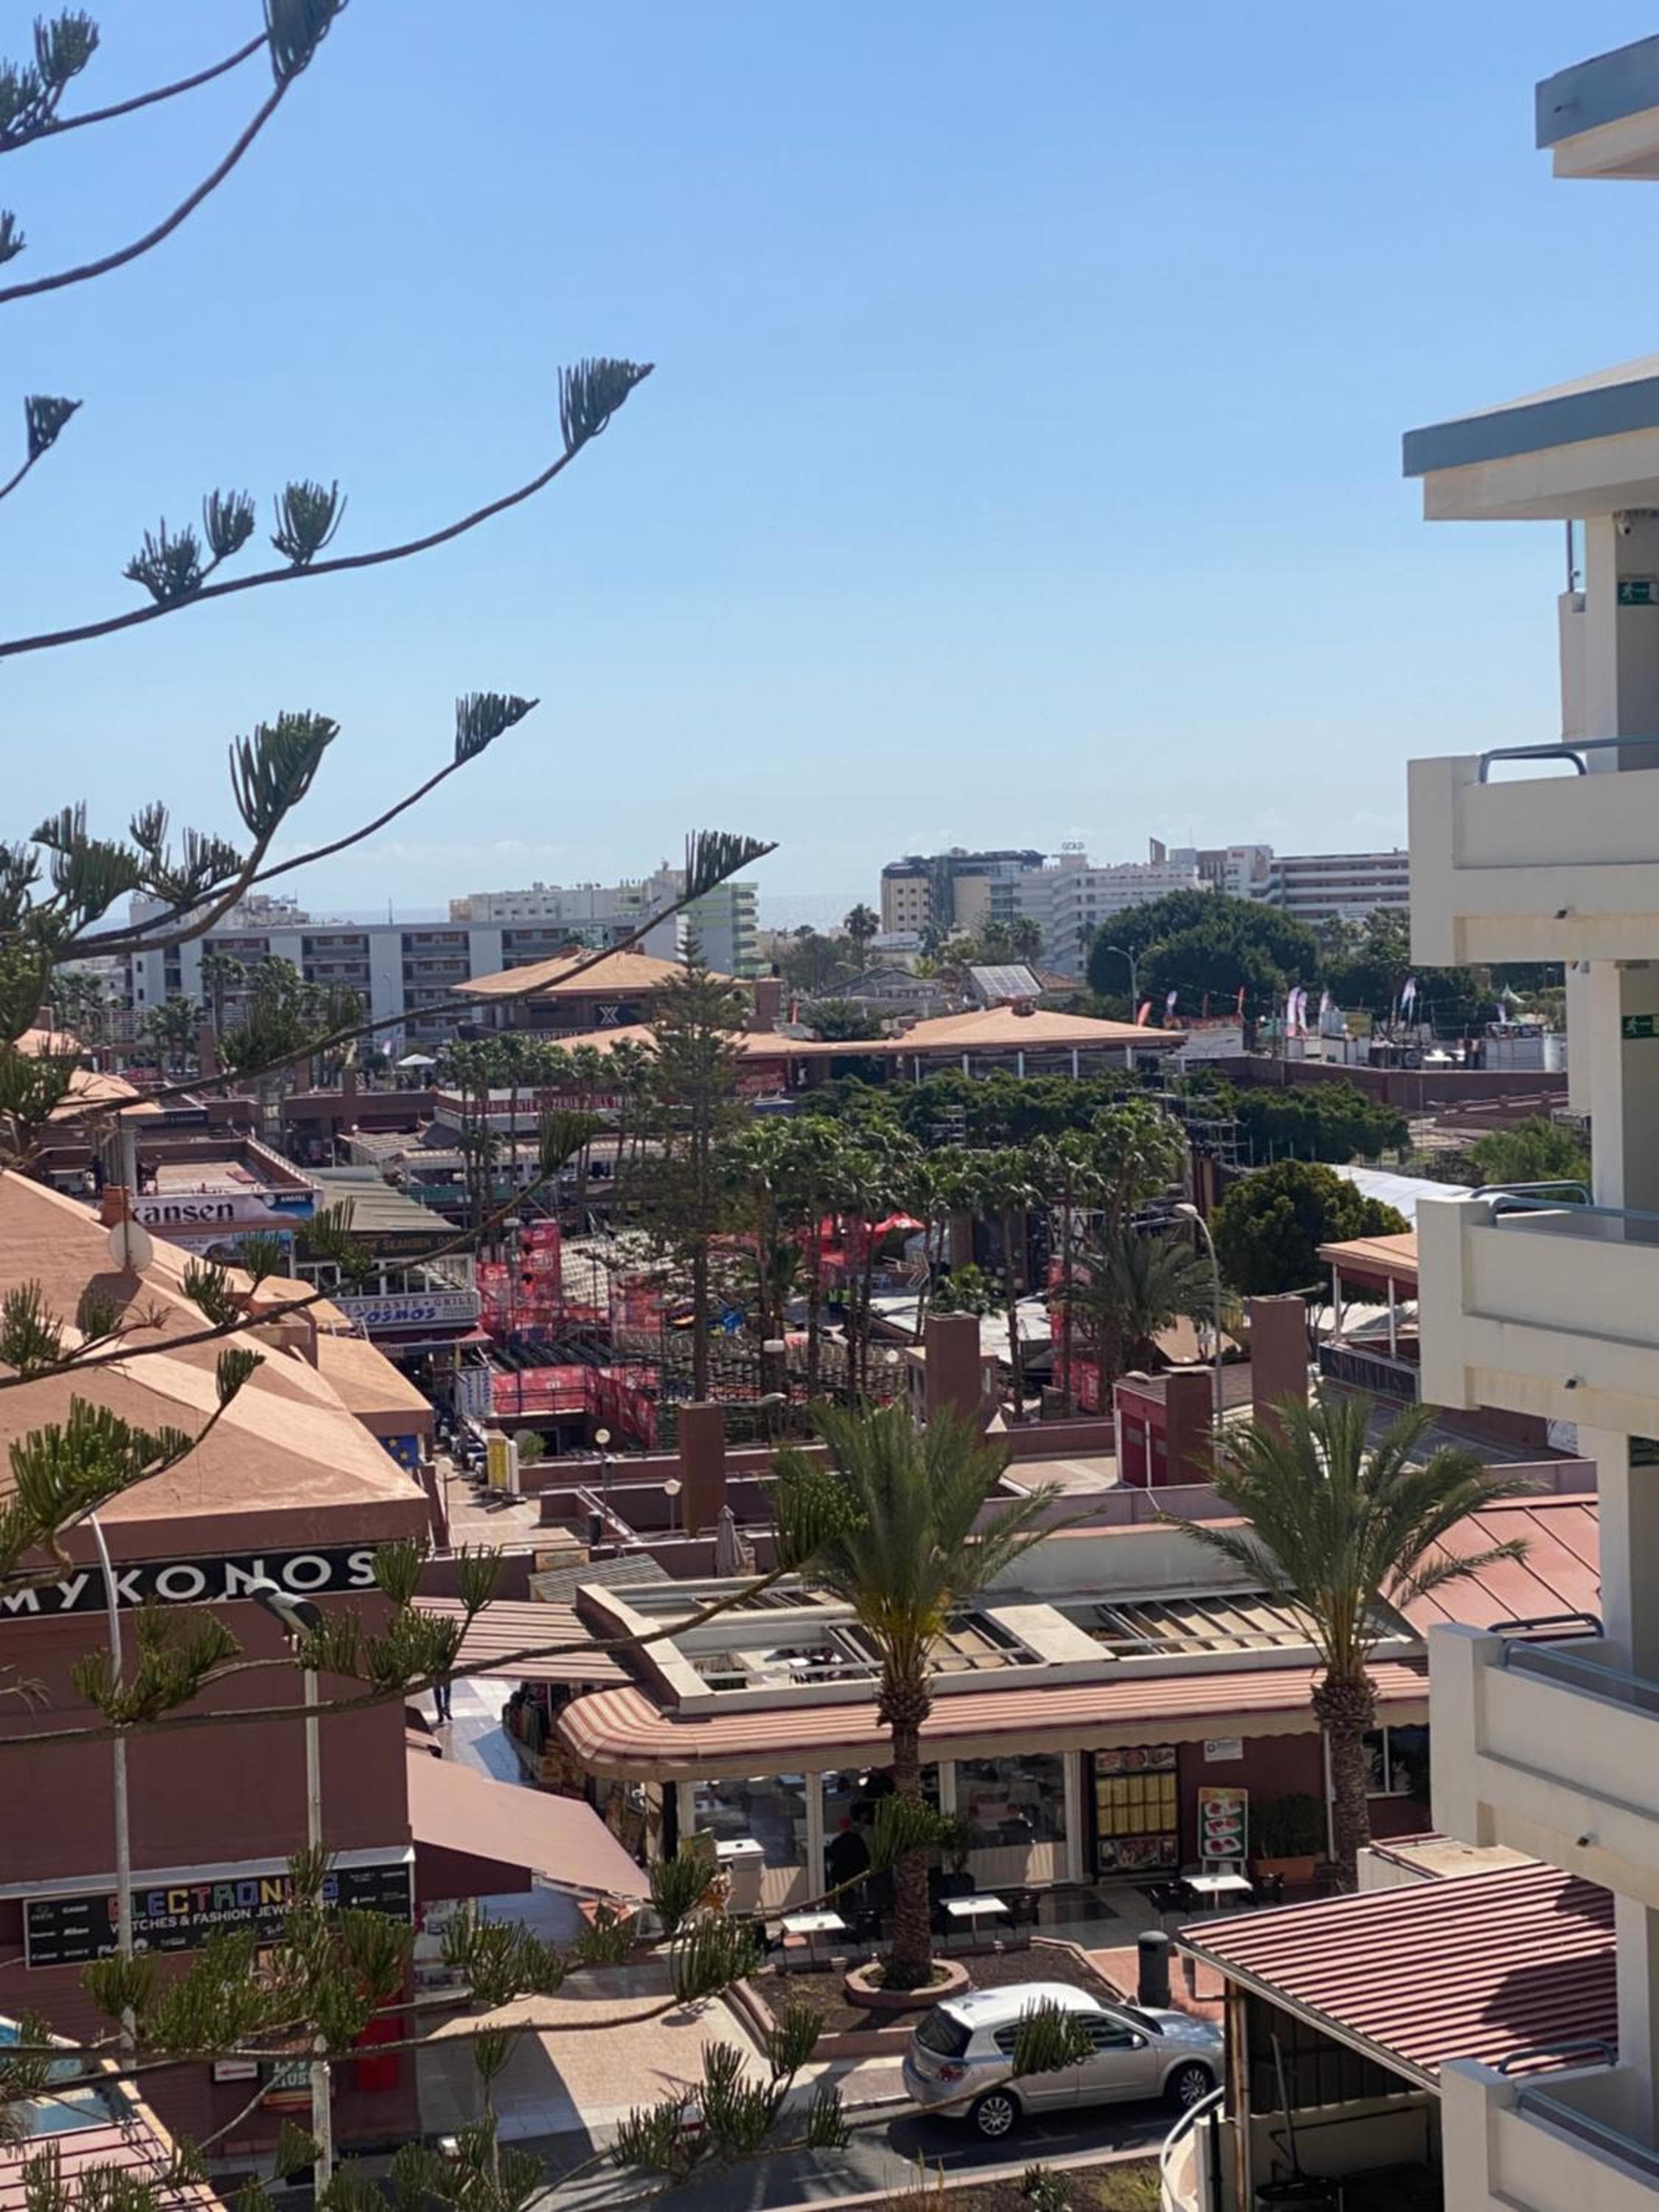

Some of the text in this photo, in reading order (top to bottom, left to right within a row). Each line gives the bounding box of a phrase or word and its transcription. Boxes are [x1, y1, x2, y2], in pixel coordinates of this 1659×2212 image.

[1, 1551, 376, 1613] MYKONOS
[111, 1916, 177, 1934] WTCHES
[193, 1908, 251, 1924] FASHION
